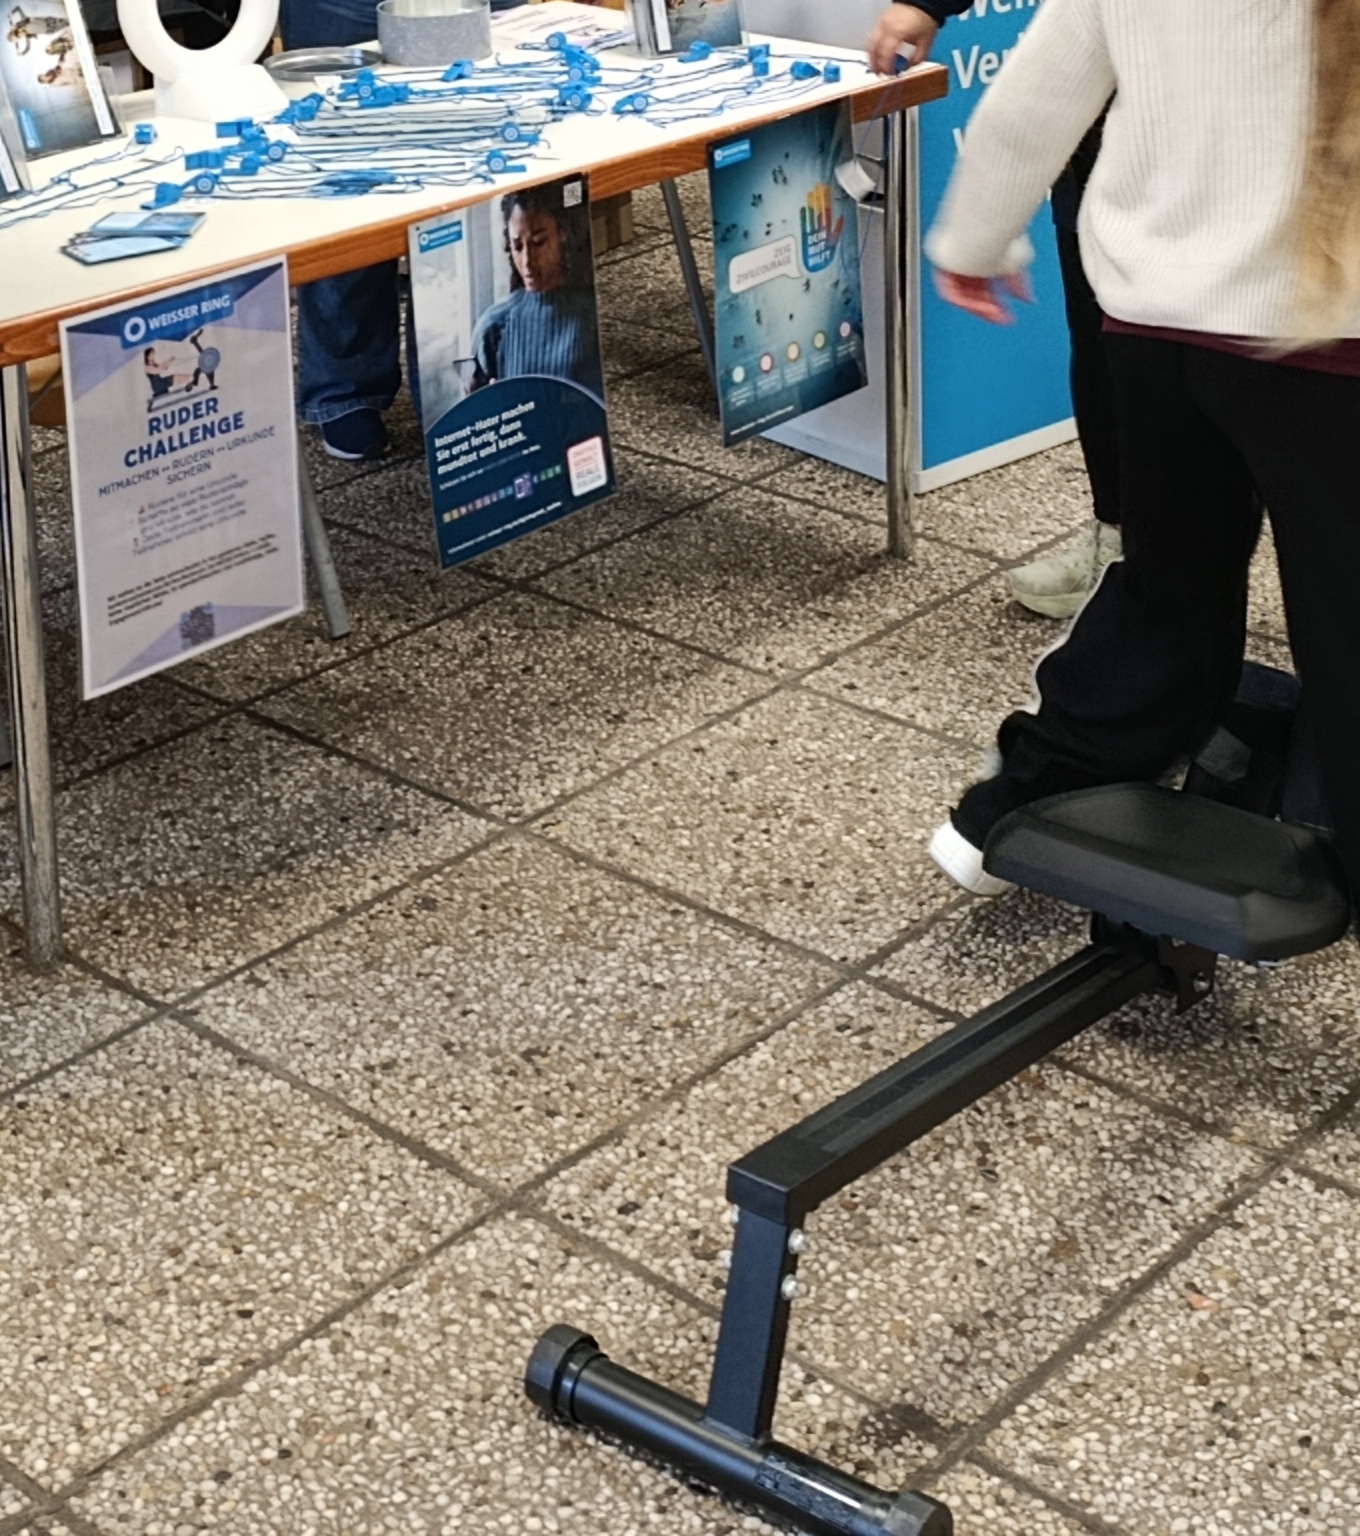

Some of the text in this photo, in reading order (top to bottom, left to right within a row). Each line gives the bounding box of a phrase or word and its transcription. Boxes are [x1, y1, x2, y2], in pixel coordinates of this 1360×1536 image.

[148, 294, 231, 330] WEISSER RING
[148, 396, 219, 436] RUDER
[124, 411, 245, 468] CHALLENGE
[99, 426, 276, 498] MITMACHEN RUDERN URKUNDE
[166, 462, 212, 485] SICHERN
